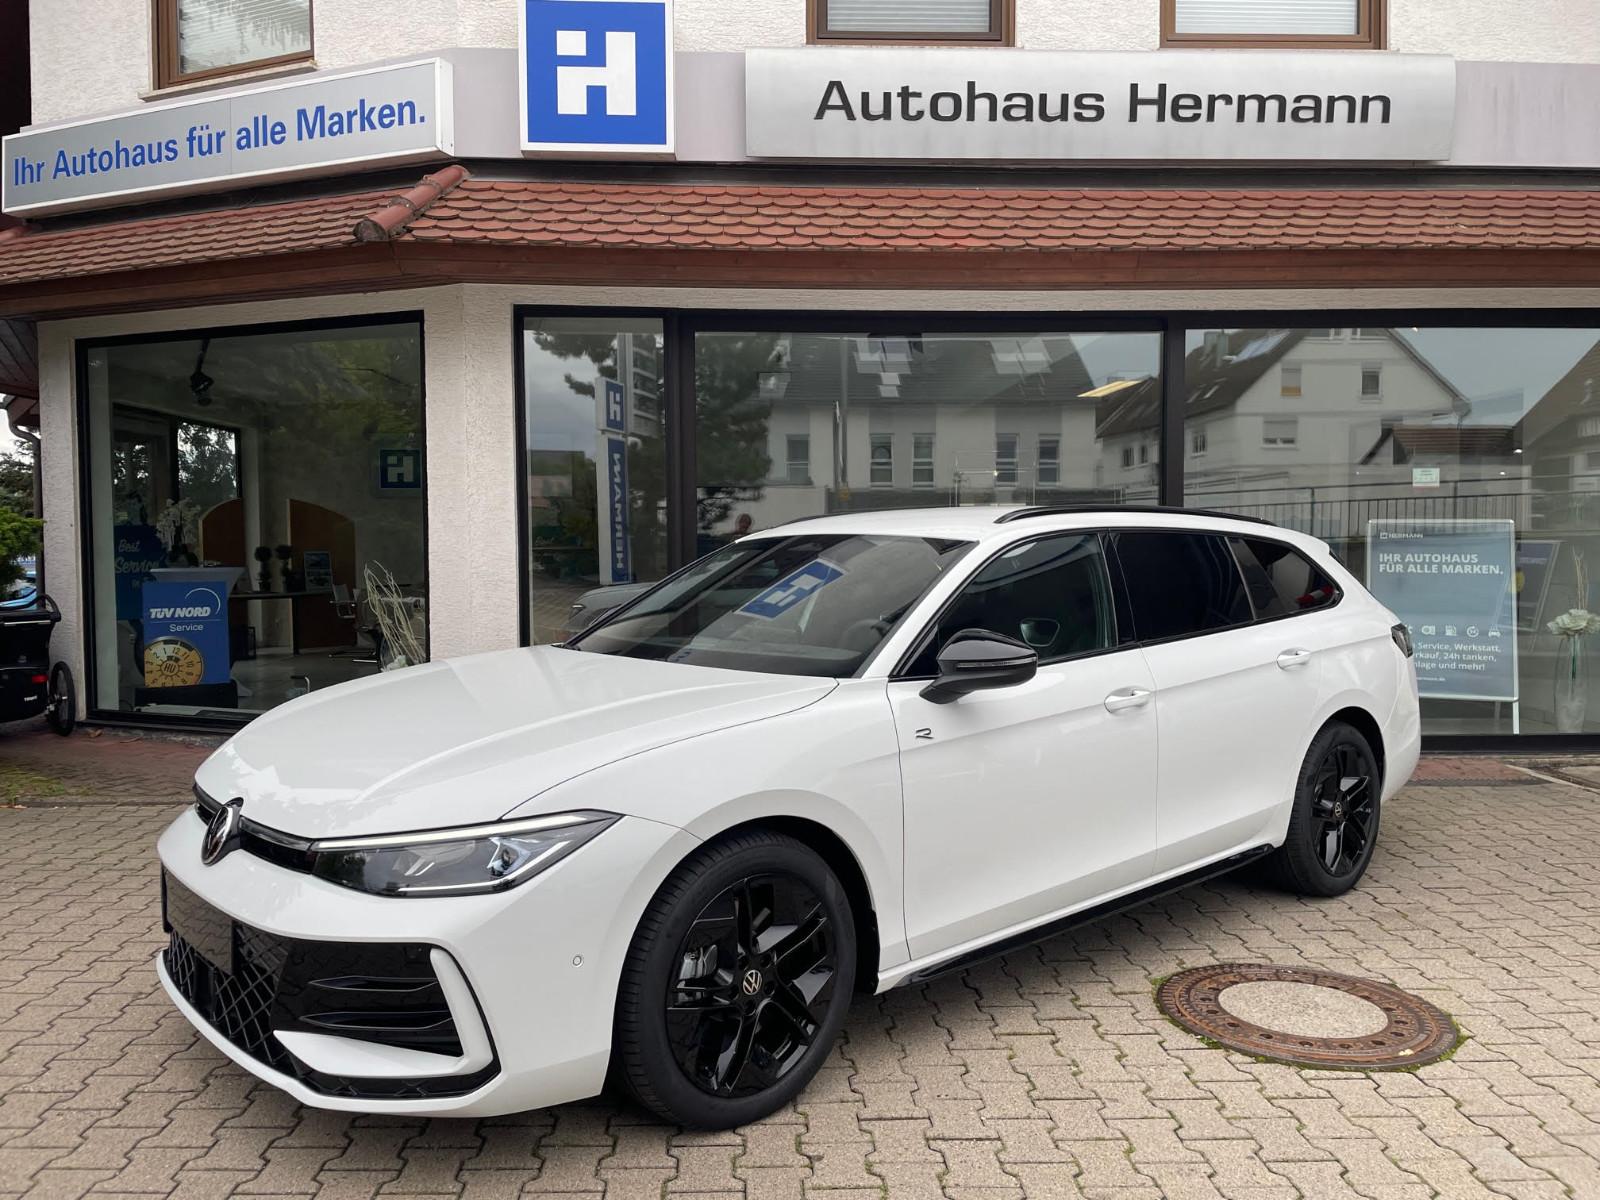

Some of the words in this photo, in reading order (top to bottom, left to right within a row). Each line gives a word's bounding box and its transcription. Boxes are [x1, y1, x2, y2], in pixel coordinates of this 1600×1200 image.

[813, 80, 1105, 122] Autohaus
[1128, 83, 1391, 123] Hermann
[14, 157, 45, 186] Ihr
[52, 139, 178, 179] Autohaus
[186, 124, 226, 158] für
[236, 114, 287, 151] alle
[297, 98, 425, 141] Marken.
[1379, 553, 1401, 563] IHR
[1405, 553, 1479, 563] AUTOHAUS
[1379, 562, 1404, 573] FÜR
[1407, 564, 1439, 573] ALLE
[1441, 564, 1504, 575] MARKEN.
[149, 607, 174, 619] TÜV
[175, 606, 211, 618] NORD
[169, 623, 204, 633] Service
[1417, 642, 1452, 652] Service,
[1454, 643, 1502, 653] Werkstatt,
[1443, 652, 1461, 661] 24h
[1462, 653, 1498, 663] tanken,
[163, 663, 177, 674] HU
[1438, 662, 1456, 670] und
[1458, 662, 1486, 671] mehr!
